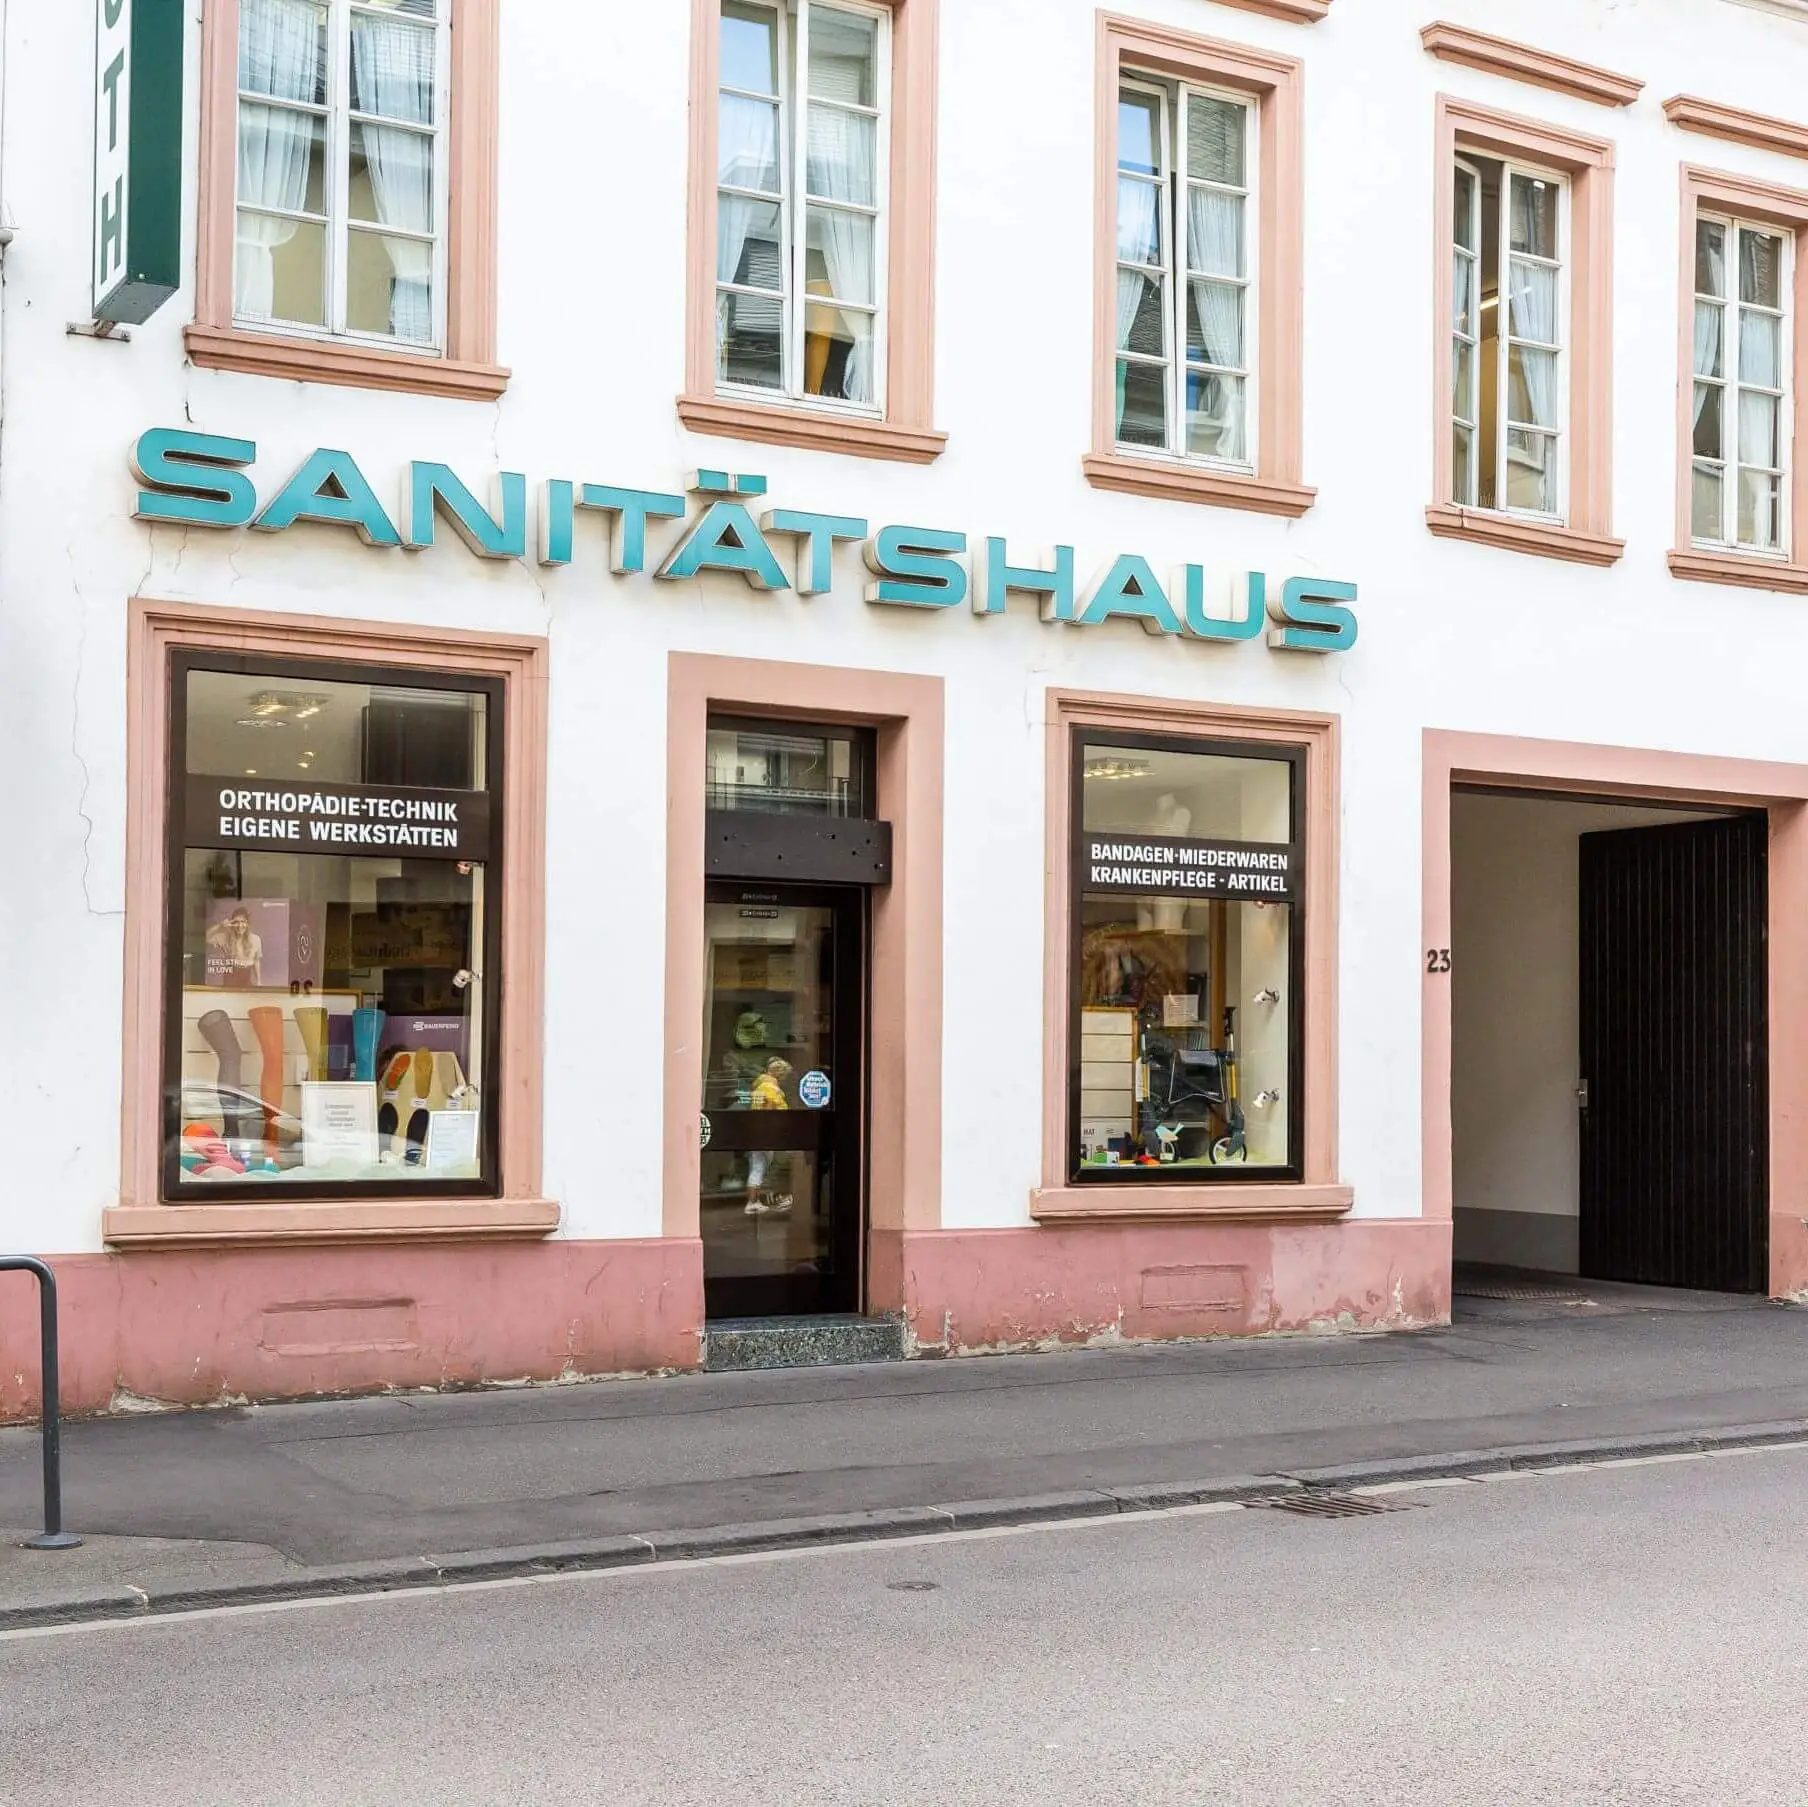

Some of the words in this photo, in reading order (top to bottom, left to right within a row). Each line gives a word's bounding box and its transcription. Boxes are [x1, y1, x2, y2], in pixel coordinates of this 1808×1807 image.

[130, 427, 1358, 652] SANITÄTSHAUS
[219, 788, 458, 822] ORTHOPÄDIE-TECHNIK
[219, 816, 300, 839] EIGENE
[309, 823, 458, 847] WERKSTÄTTEN
[1091, 866, 1216, 888] KRANKENPFLEGE
[1227, 873, 1288, 893] ARTIKEL
[1427, 949, 1451, 973] 23
